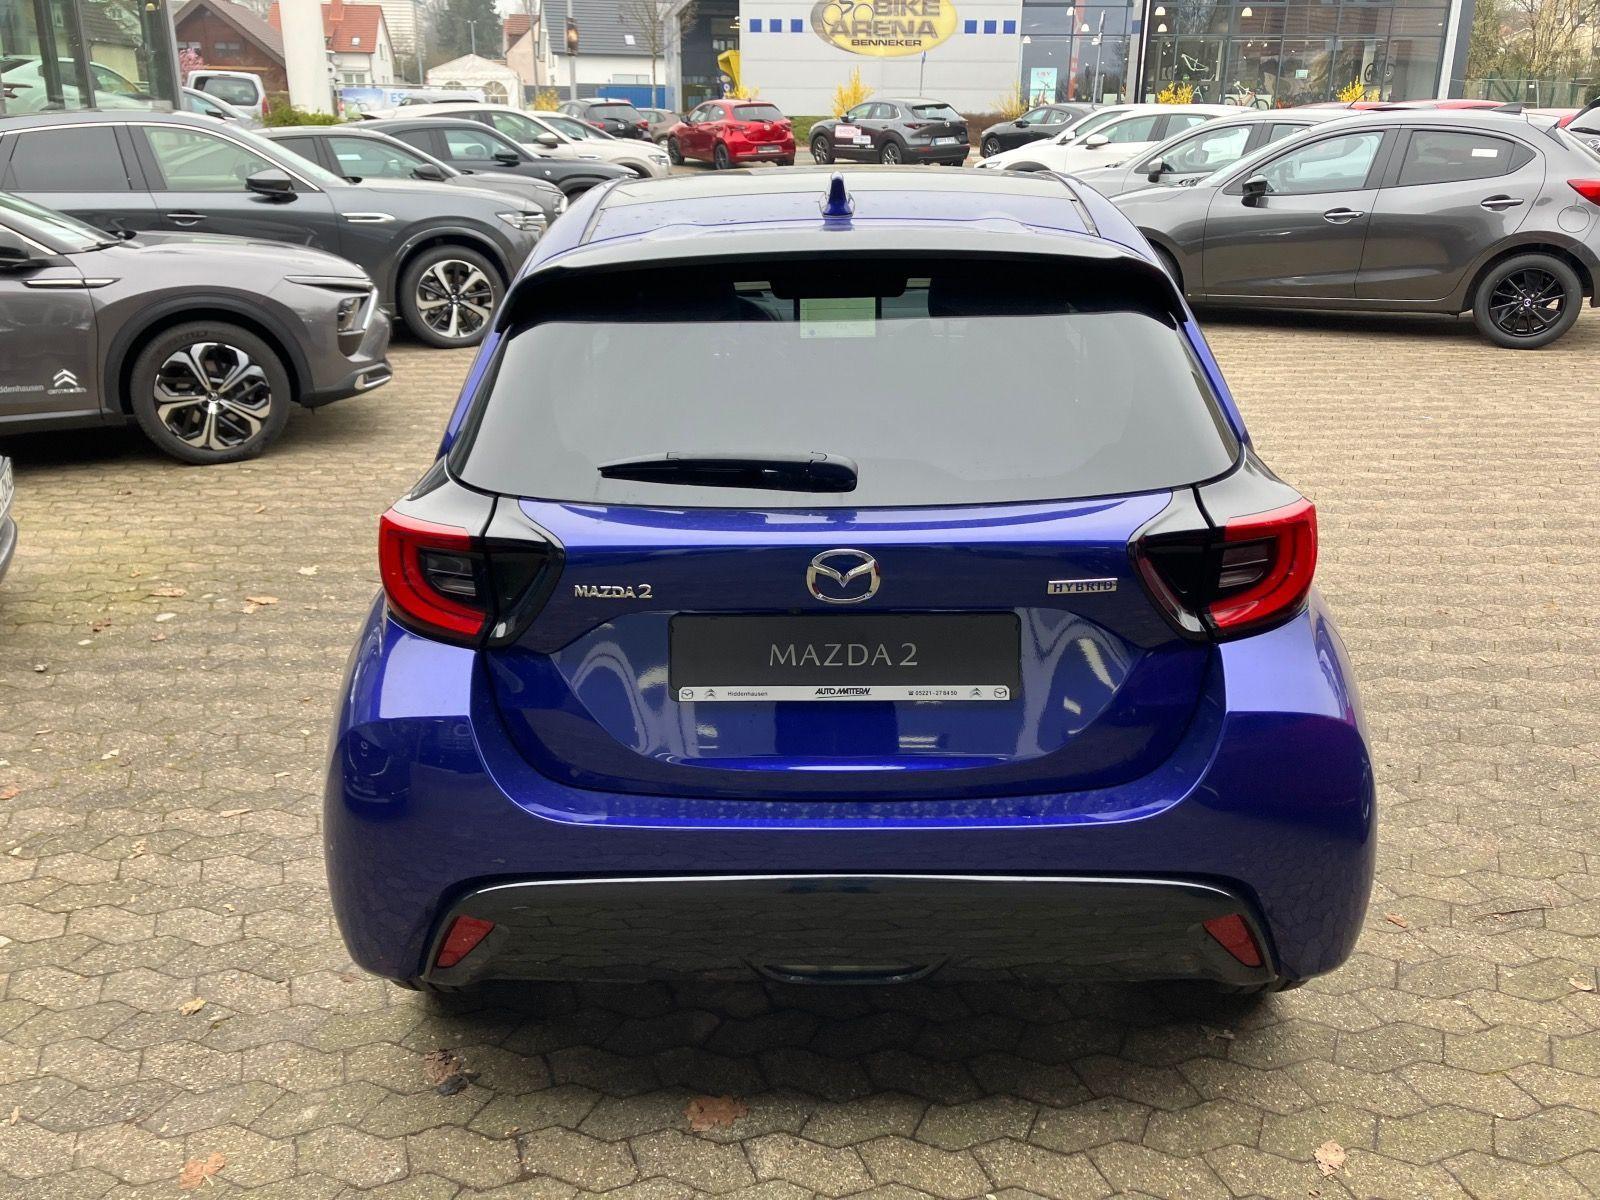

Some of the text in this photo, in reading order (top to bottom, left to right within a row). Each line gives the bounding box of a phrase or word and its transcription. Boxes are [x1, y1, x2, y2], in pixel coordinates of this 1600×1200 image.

[873, 0, 940, 16] BIKE
[829, 20, 939, 38] ARENA
[1053, 581, 1113, 592] HYBRID
[769, 642, 918, 667] MAZDA 2
[815, 687, 871, 695] AUTO MATTERN
